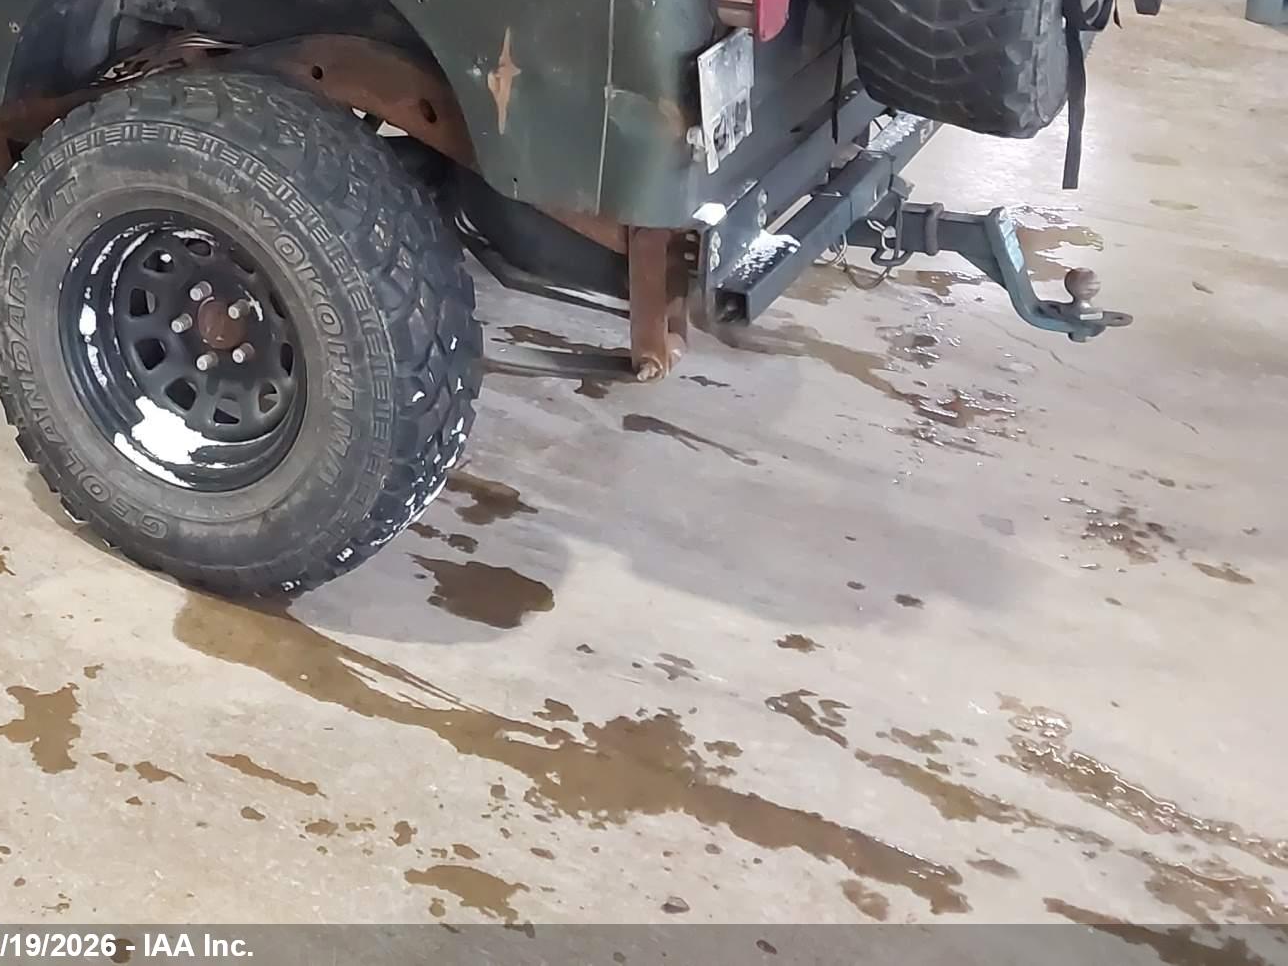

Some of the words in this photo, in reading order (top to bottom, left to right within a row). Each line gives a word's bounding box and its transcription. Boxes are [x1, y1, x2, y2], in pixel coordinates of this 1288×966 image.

[20, 175, 80, 256] M/T
[250, 200, 357, 486] YOKOHAMA
[7, 265, 170, 540] GEOLANDAR
